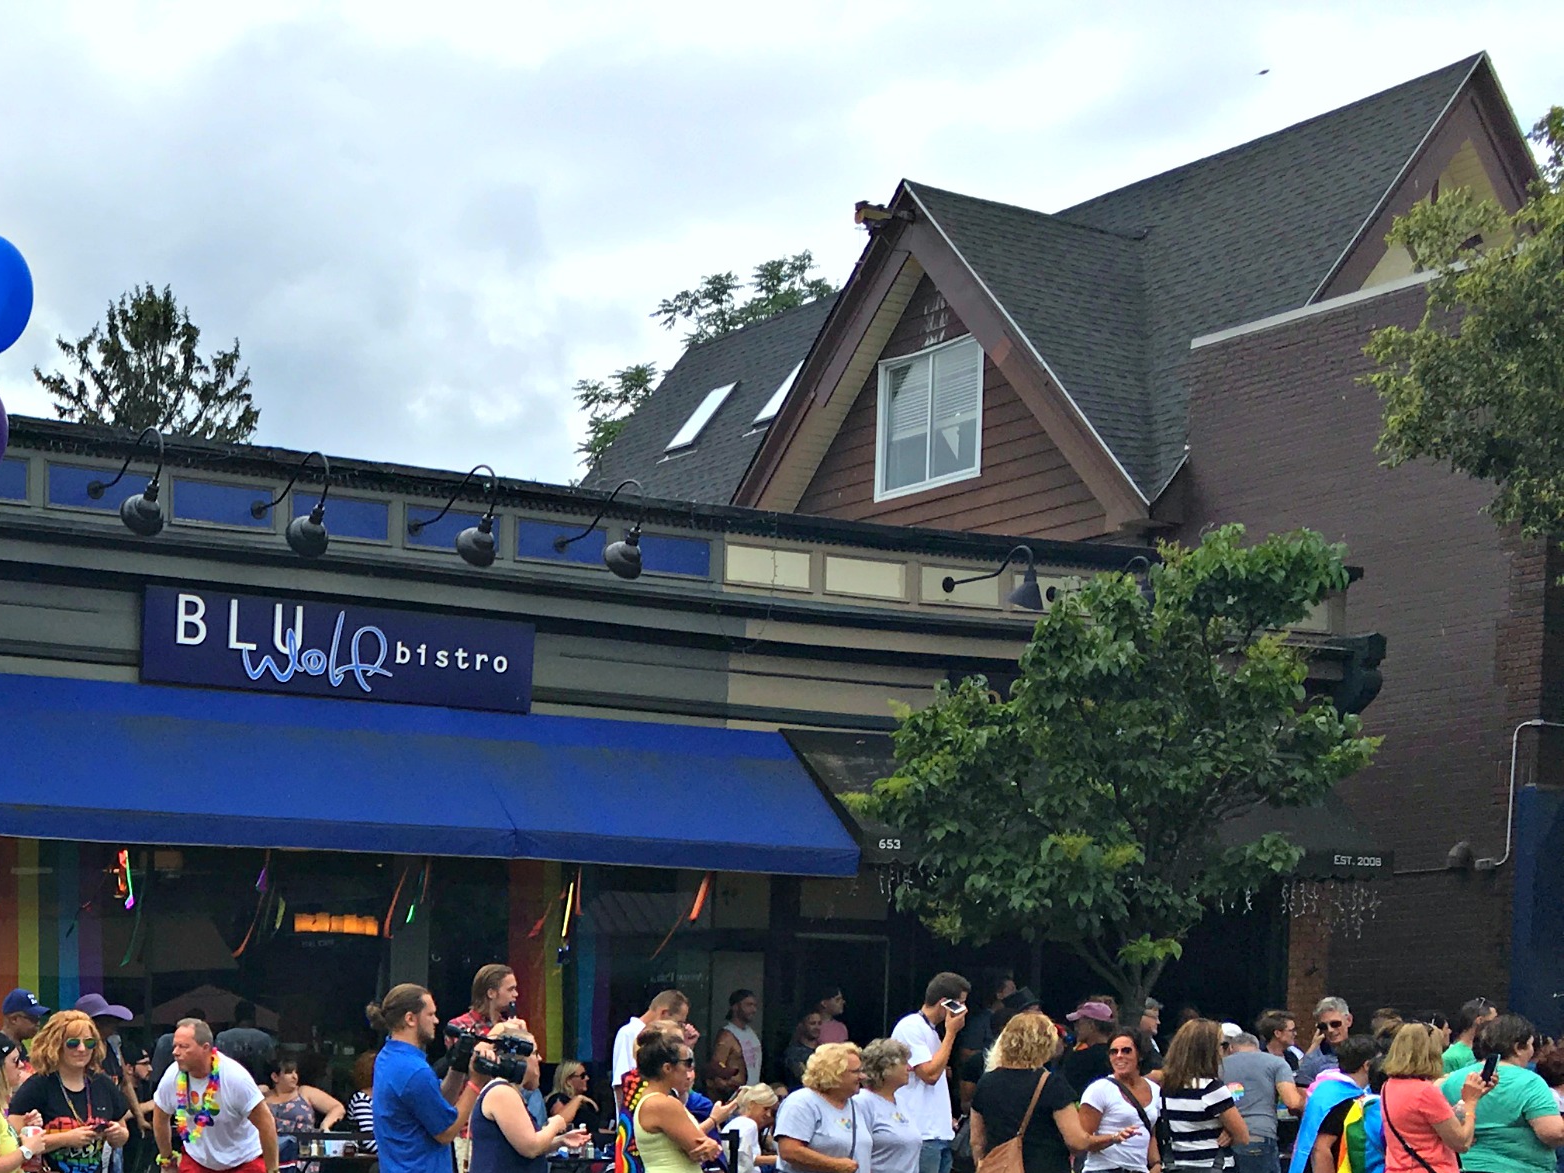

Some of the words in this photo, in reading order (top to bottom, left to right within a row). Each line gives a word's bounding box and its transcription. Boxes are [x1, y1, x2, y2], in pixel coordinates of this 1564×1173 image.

[174, 593, 303, 655] BLU
[395, 641, 509, 674] bistro
[878, 838, 901, 850] 653
[1333, 854, 1355, 866] EST.
